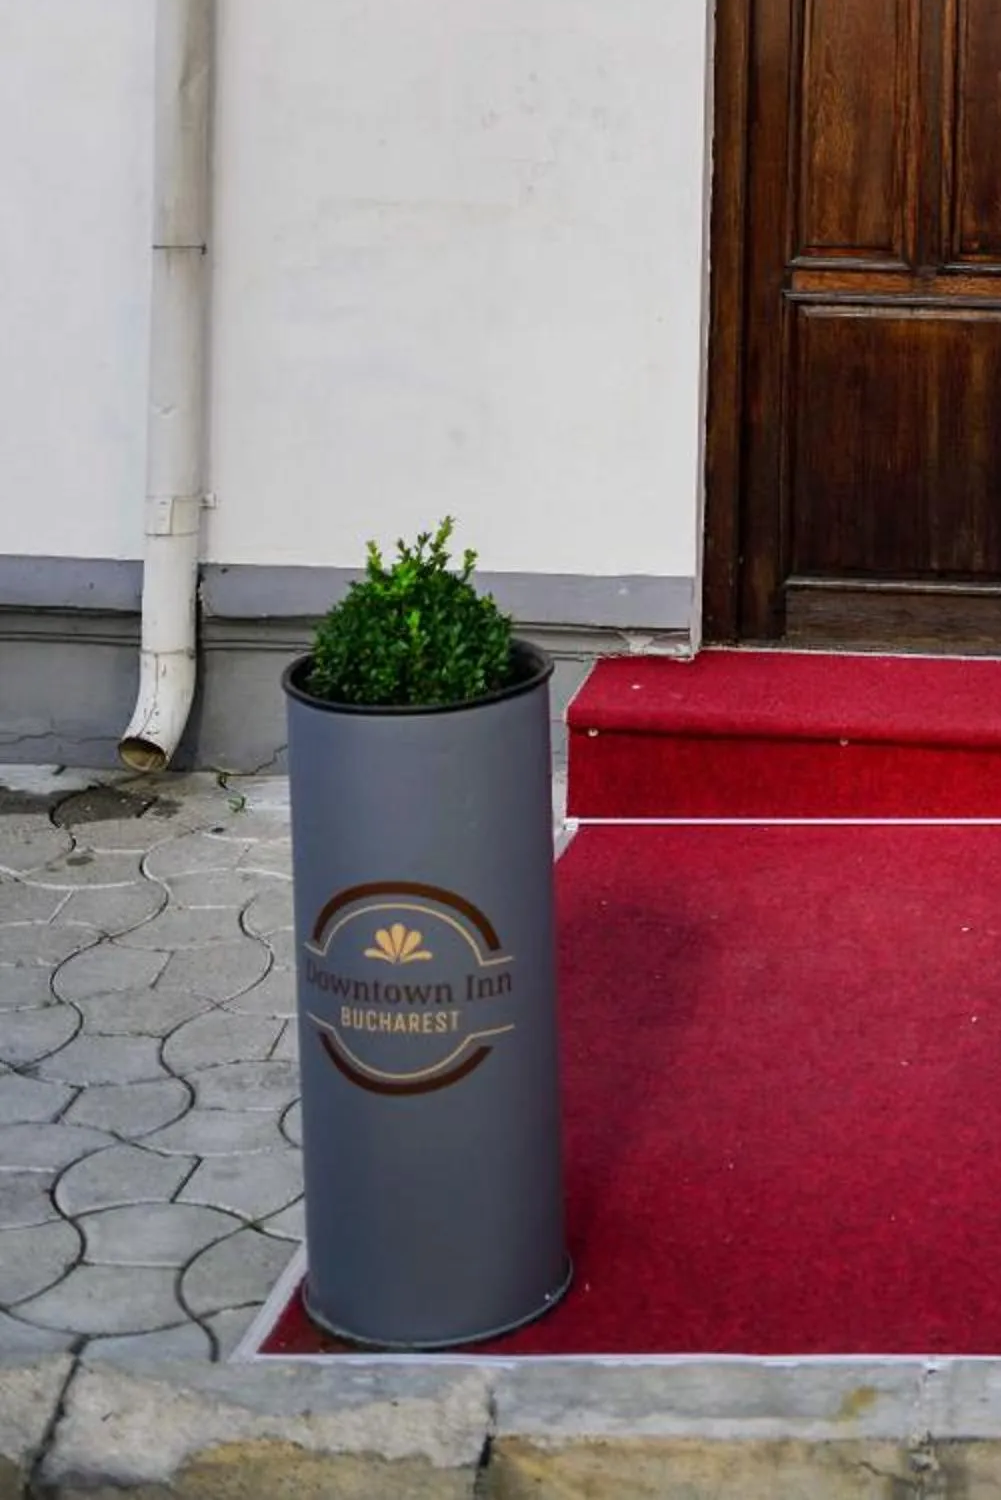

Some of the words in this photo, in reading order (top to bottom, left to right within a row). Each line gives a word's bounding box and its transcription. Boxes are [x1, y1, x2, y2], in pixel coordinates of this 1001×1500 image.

[305, 957, 454, 1005] Downtown
[466, 971, 513, 1000] Inn
[340, 1005, 462, 1034] BUCHAREST
